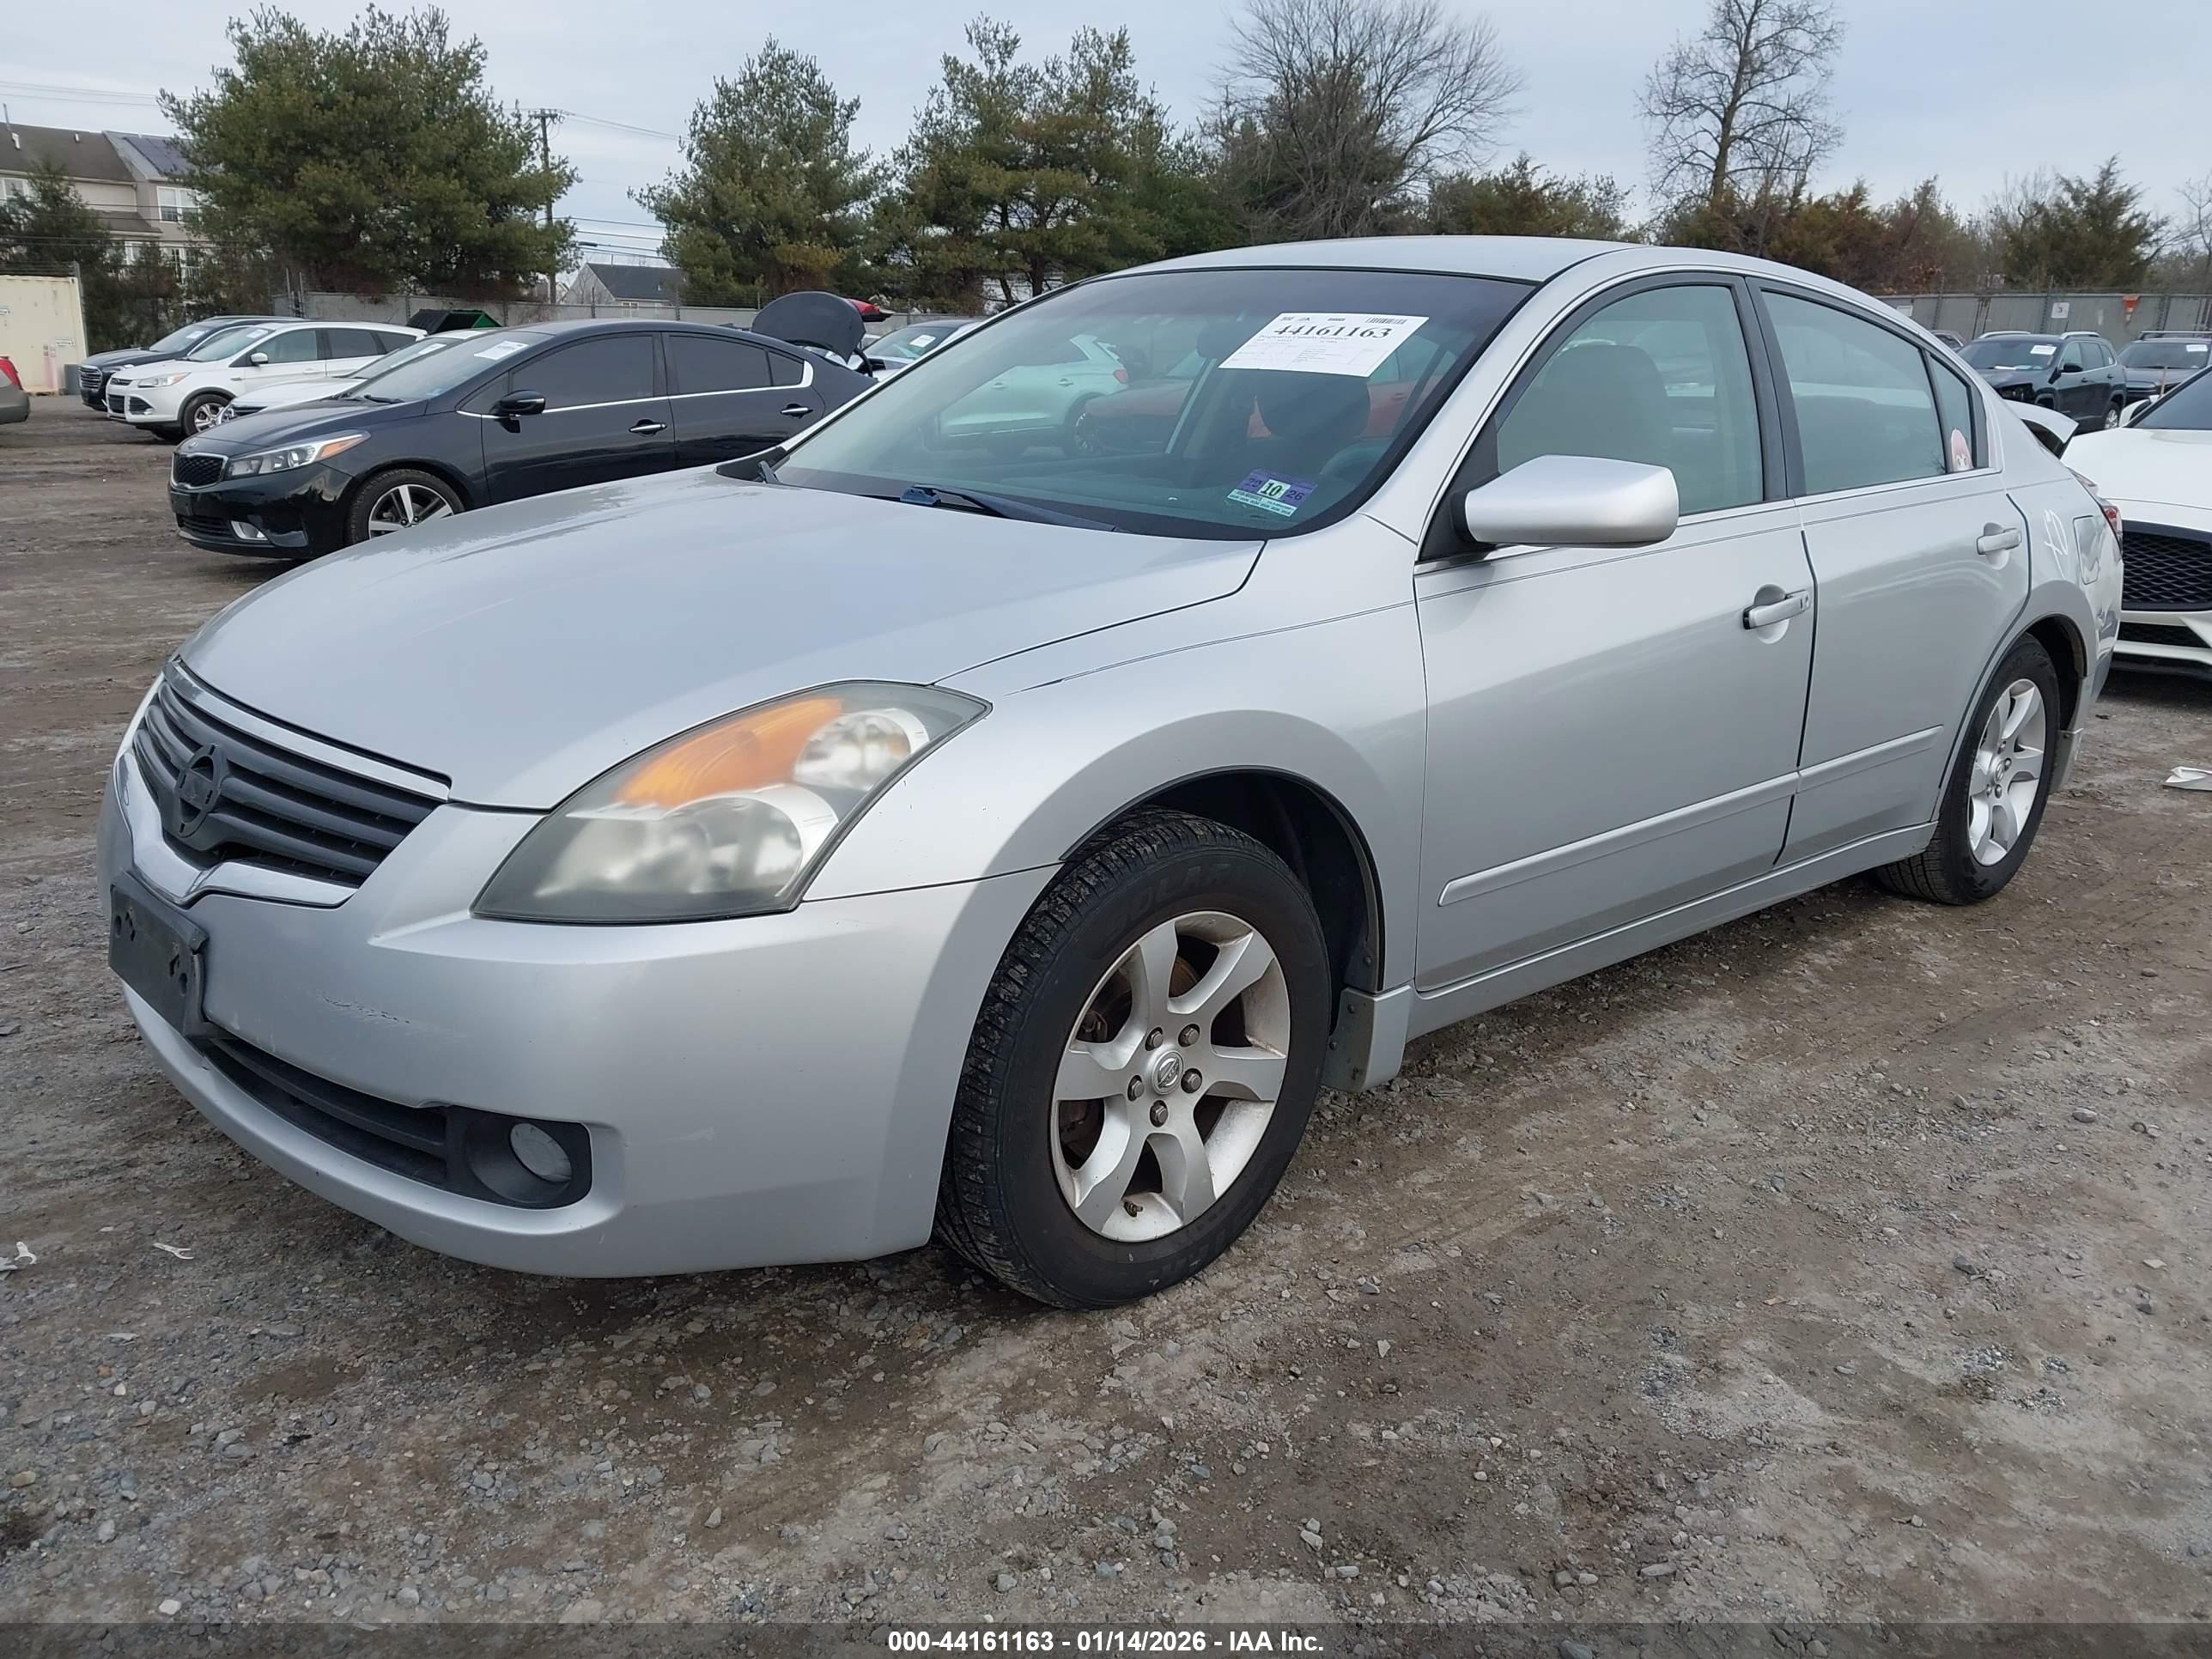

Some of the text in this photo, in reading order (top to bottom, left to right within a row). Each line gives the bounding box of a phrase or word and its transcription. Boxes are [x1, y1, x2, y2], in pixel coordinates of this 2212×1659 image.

[1273, 325, 1392, 338] 44161163
[1261, 481, 1283, 496] 10
[1286, 489, 1305, 501] 26
